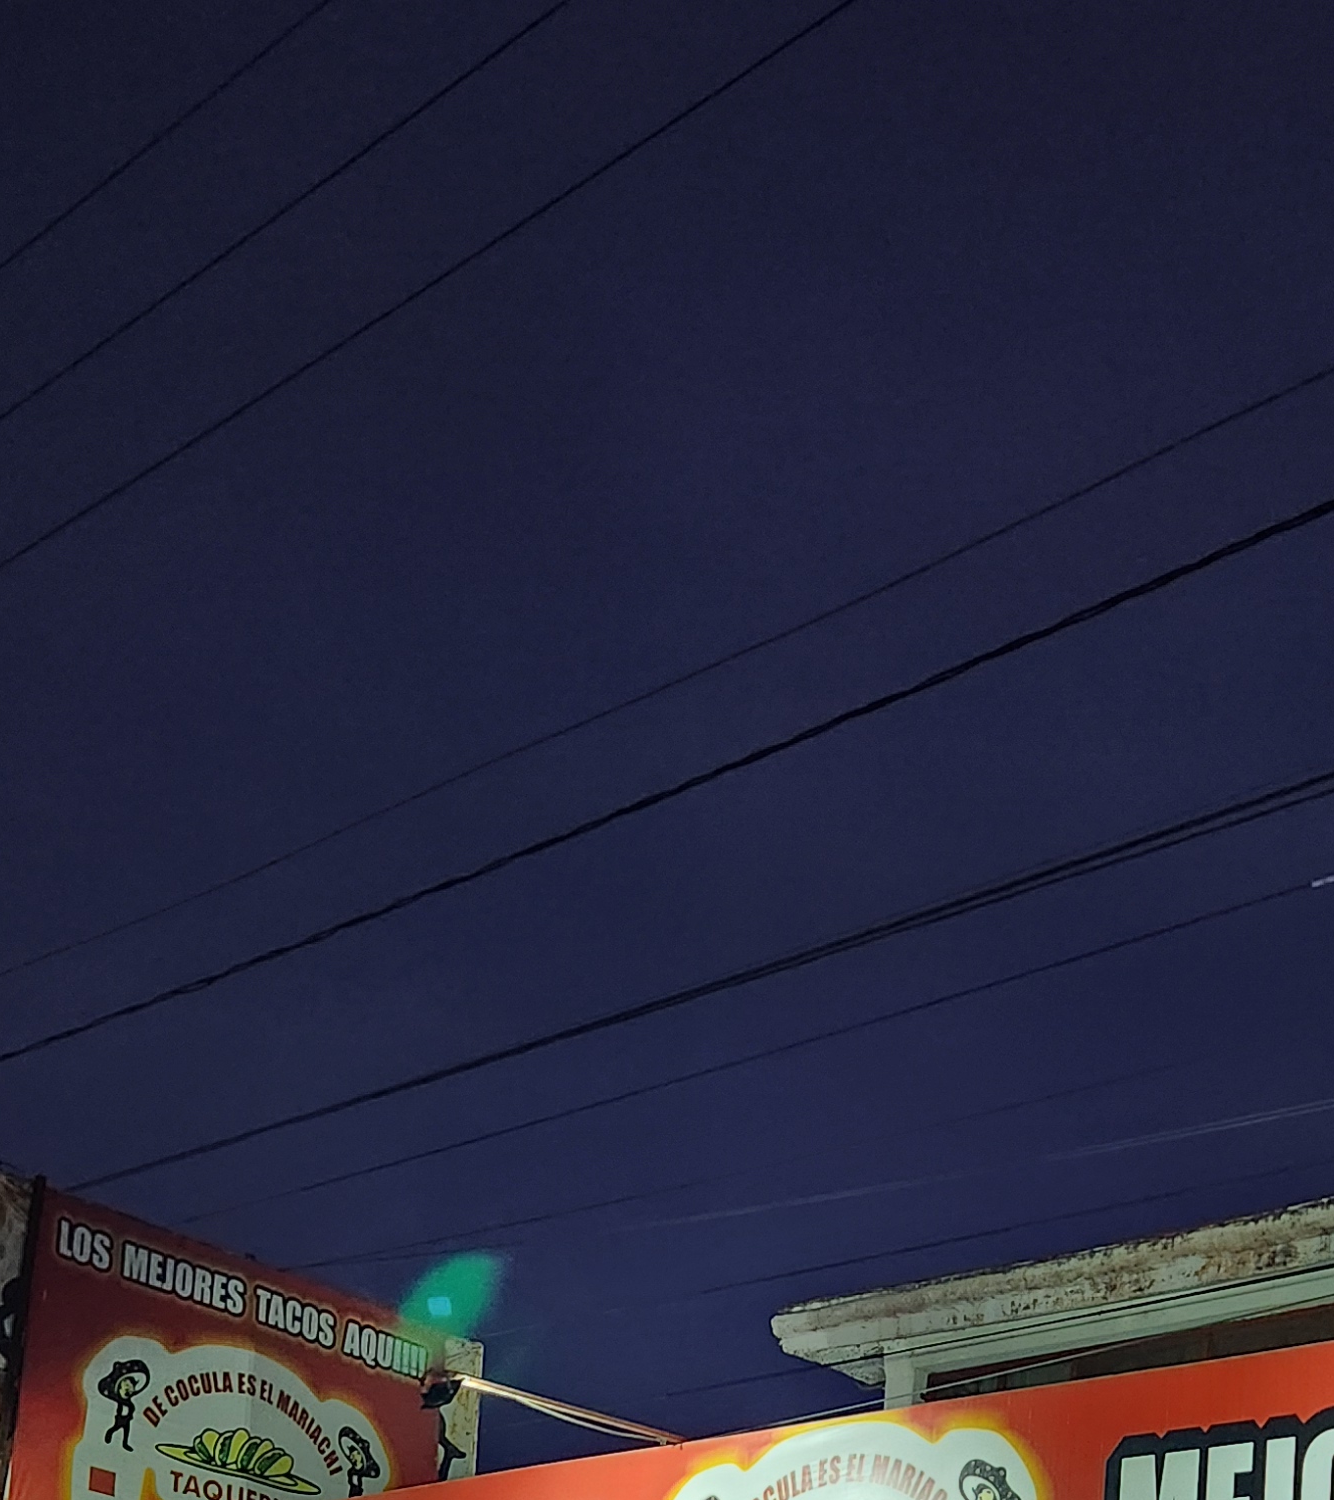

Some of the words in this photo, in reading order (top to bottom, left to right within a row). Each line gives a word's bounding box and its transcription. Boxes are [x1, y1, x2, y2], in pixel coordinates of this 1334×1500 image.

[58, 1219, 112, 1270] LOS
[123, 1242, 245, 1314] MEJORES
[255, 1288, 336, 1348] TACOS
[143, 1400, 168, 1427] DE
[165, 1373, 232, 1408] COCULA
[238, 1372, 258, 1394] ES
[260, 1380, 275, 1404] EL
[276, 1393, 343, 1476] MARIACHI
[818, 1456, 842, 1487] ES
[846, 1453, 867, 1482] EL
